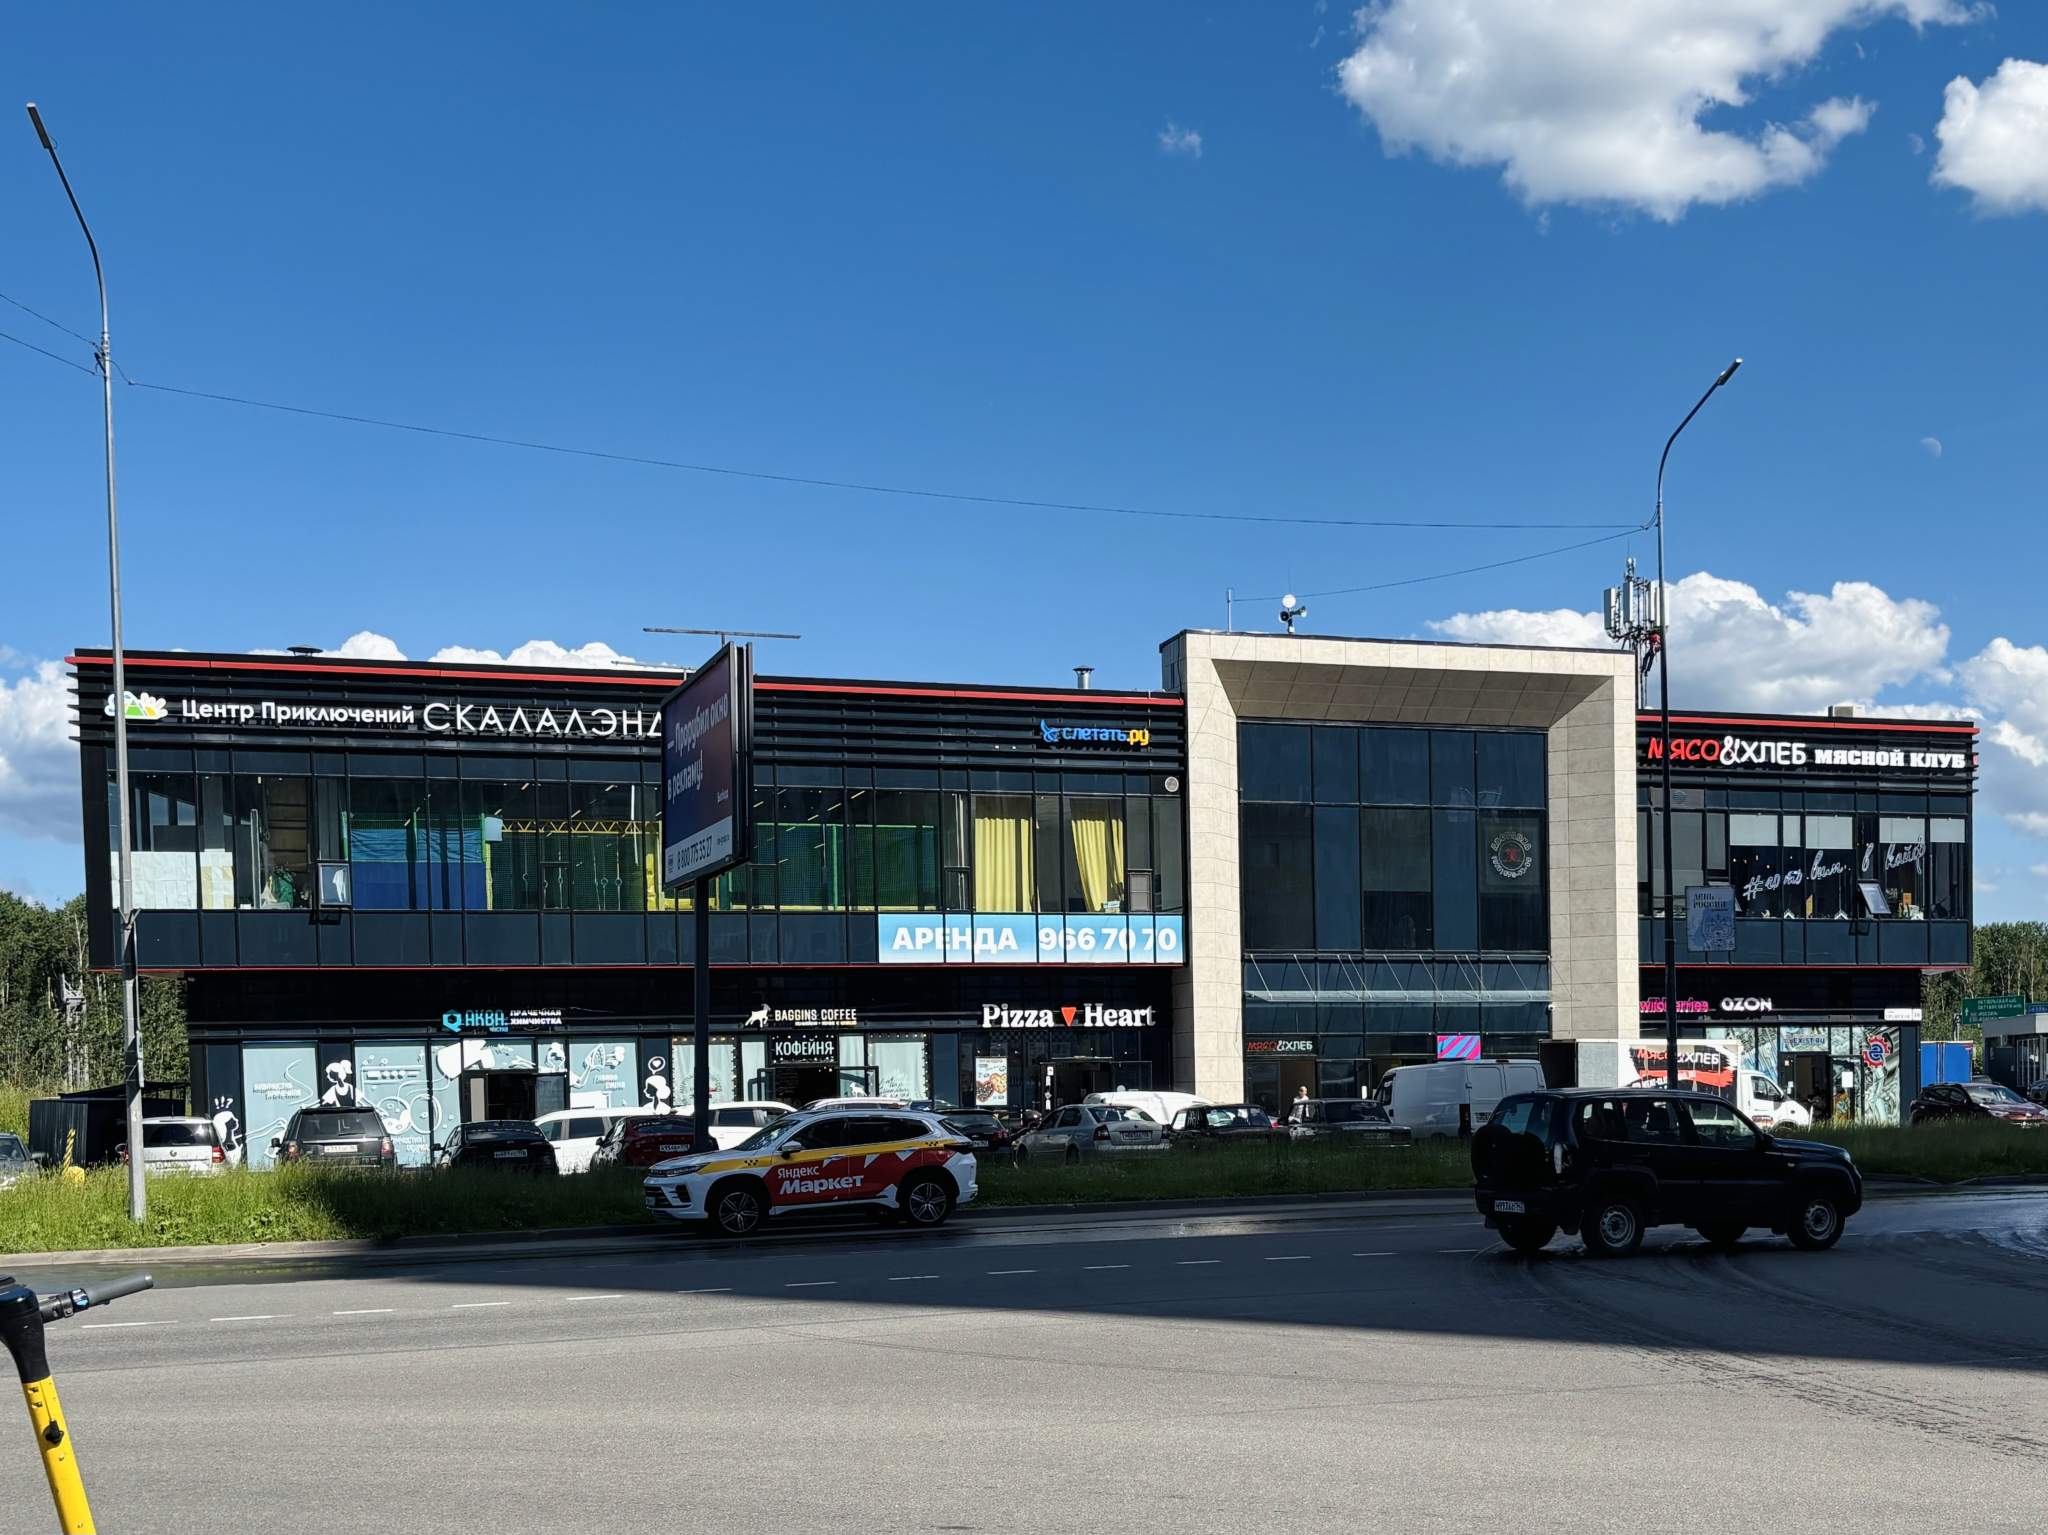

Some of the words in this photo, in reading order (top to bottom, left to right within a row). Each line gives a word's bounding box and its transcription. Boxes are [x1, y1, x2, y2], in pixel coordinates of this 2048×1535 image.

[182, 699, 254, 722] Центр
[261, 701, 415, 724] Приключений
[675, 706, 710, 757] Прорубил
[710, 693, 728, 726] окно
[1062, 727, 1149, 746] слетать.ру
[1814, 748, 1905, 767] МЯСНОЙ
[1910, 752, 1966, 769] КЛУБ
[672, 749, 703, 805] рекламу!
[892, 927, 1018, 954] АРЕНДА
[1039, 927, 1096, 951] 966
[1101, 928, 1136, 951] 70
[1142, 928, 1177, 951] 70
[510, 1009, 562, 1017] ПРАЧЕЧНАЯ
[1639, 997, 1709, 1013] wilderries
[1721, 997, 1773, 1011] OZON
[774, 1009, 818, 1021] BAGGINS
[821, 1009, 857, 1020] COFFEE
[982, 1003, 1055, 1028] Pizza
[1084, 1003, 1156, 1027] Heart
[775, 1038, 834, 1056] КОФЕЙНЯ
[777, 1166, 820, 1179] Яндекс
[780, 1175, 864, 1194] Маркет
